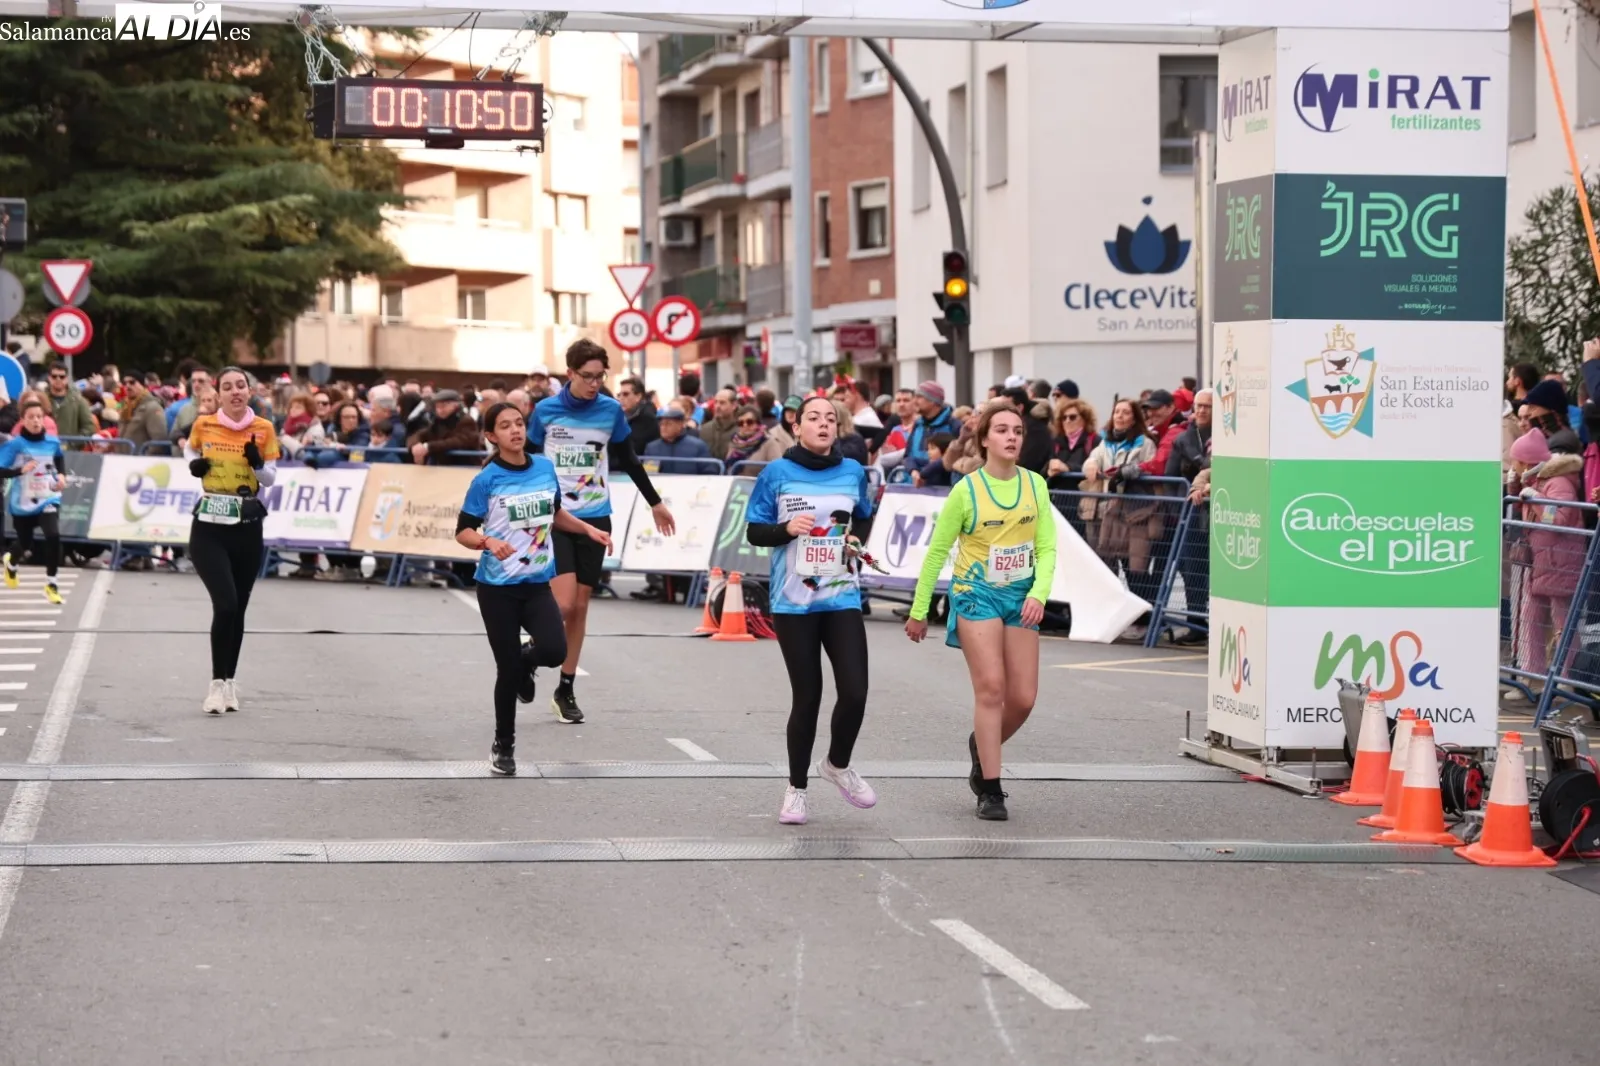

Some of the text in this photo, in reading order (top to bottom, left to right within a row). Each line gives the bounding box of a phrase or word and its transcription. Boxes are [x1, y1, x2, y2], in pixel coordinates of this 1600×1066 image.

[372, 86, 533, 131] 00:10:50
[1390, 114, 1482, 131] fertilizantes
[1319, 180, 1460, 259] JRG
[1411, 274, 1458, 283] SOLUCIONES
[1383, 284, 1458, 293] VISUALES A MEDIDA
[55, 322, 81, 340] 30
[619, 322, 644, 338] 30
[1097, 317, 1128, 332] San
[1380, 375, 1490, 391] San Estanislao
[1380, 393, 1454, 408] de Kostka
[560, 452, 586, 466] 6274
[515, 501, 541, 519] 6170
[1289, 507, 1475, 532] autoescuelas
[811, 538, 844, 546] SETEL
[1003, 544, 1031, 555] SETEL
[805, 546, 836, 564] 6194
[1339, 532, 1475, 570] el pilar
[995, 553, 1025, 571] 6249
[1286, 707, 1476, 723] MERCAANCA
